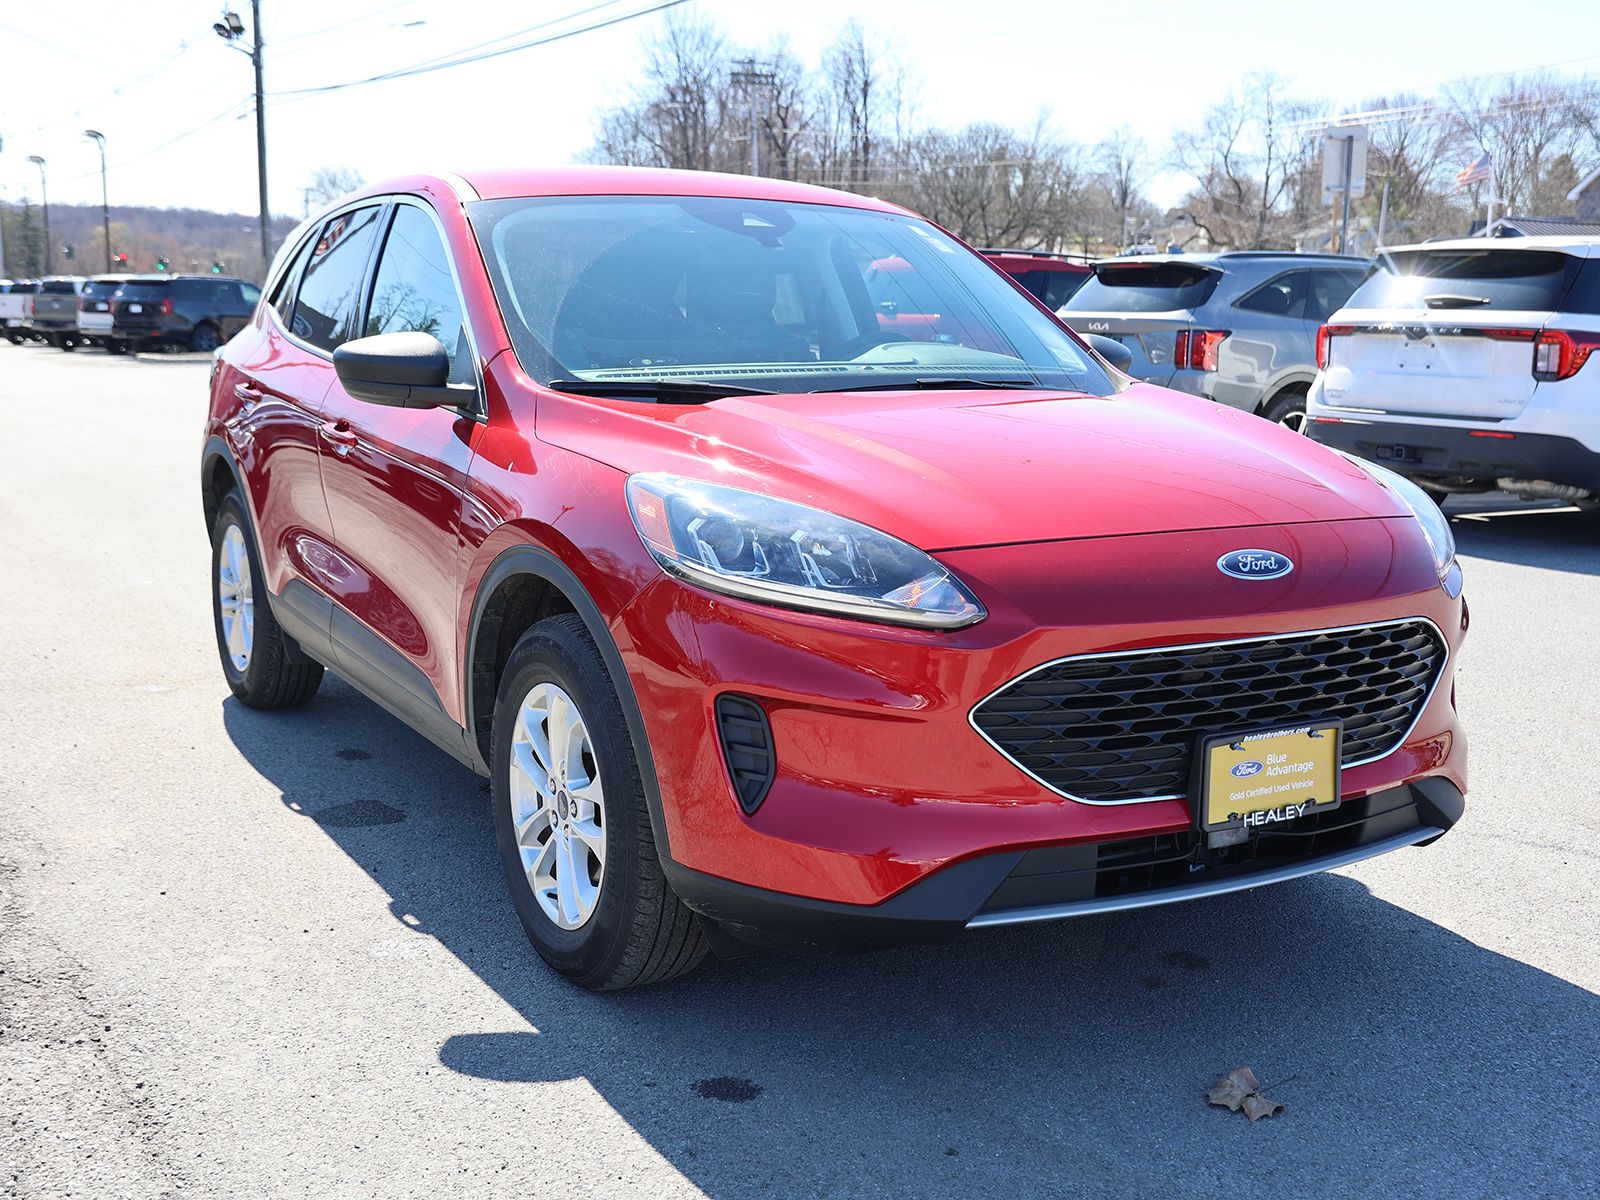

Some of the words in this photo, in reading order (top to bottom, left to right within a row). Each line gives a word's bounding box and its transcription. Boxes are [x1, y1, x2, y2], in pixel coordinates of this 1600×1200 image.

[1237, 553, 1279, 572] Ford
[1243, 727, 1311, 742] healeybrothers.com
[1266, 753, 1287, 765] Blue
[1265, 761, 1315, 778] Advantage
[1229, 791, 1245, 801] Gold
[1246, 786, 1273, 798] Certified
[1274, 781, 1290, 793] Used
[1291, 779, 1314, 790] Vehicle
[1243, 803, 1307, 828] HEALEY
